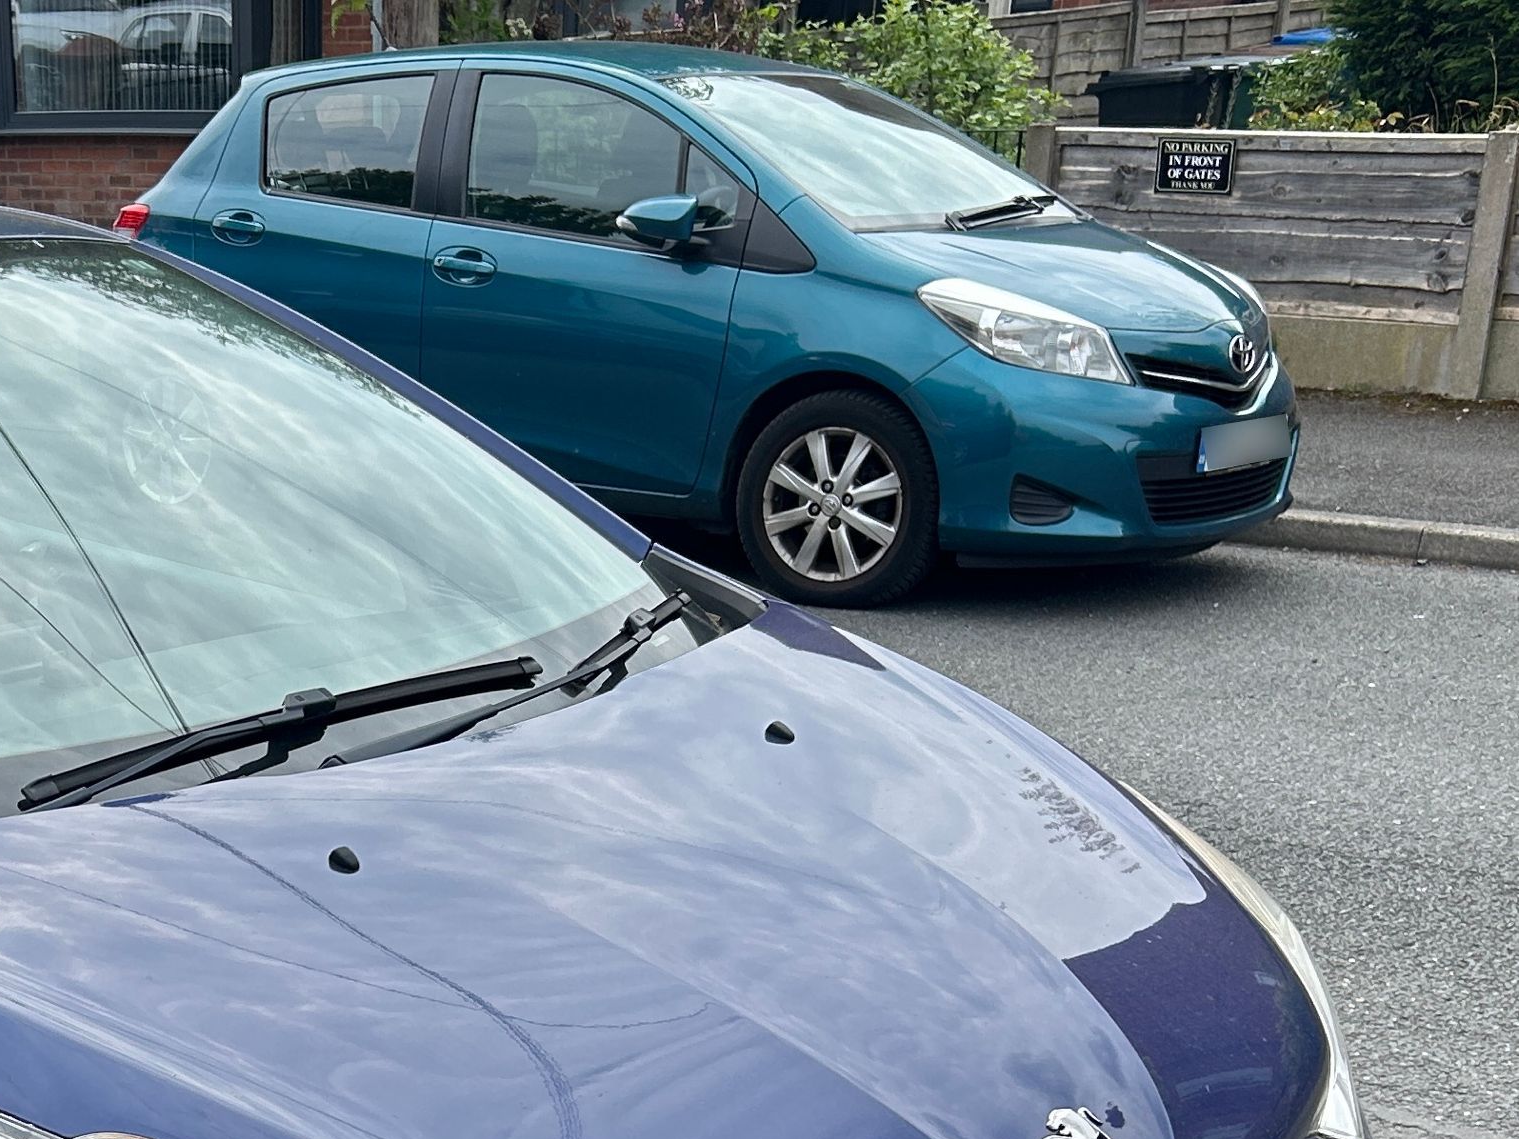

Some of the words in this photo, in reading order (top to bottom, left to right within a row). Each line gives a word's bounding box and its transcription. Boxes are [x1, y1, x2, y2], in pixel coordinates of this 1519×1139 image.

[1165, 142, 1179, 152] NO
[1182, 143, 1229, 154] PARKING
[1169, 155, 1182, 166] IN
[1184, 155, 1222, 167] FRONT
[1167, 168, 1183, 179] OF
[1184, 168, 1221, 180] GATES
[1171, 180, 1198, 189] THANK
